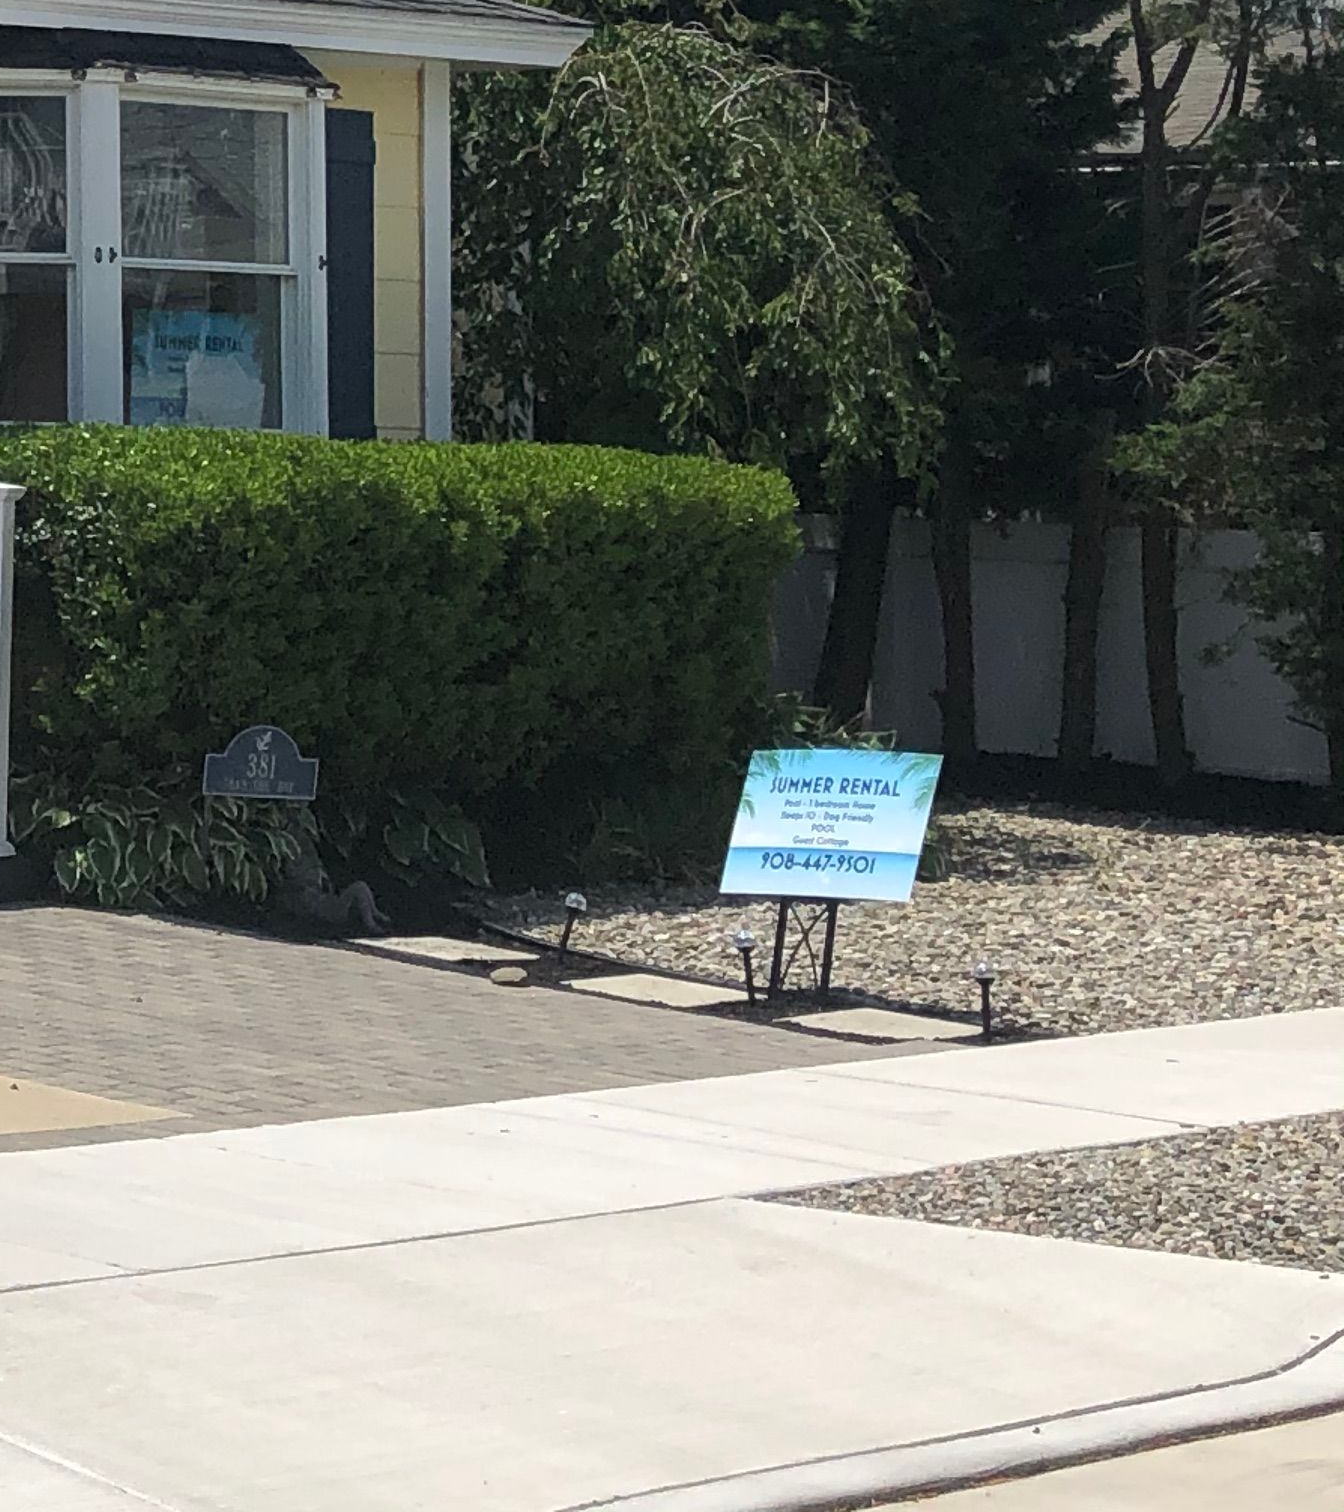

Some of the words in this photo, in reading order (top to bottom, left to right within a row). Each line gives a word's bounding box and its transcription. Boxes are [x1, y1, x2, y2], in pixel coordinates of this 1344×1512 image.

[154, 334, 200, 351] SUMMER
[205, 335, 243, 353] RENTAL
[246, 753, 276, 779] 381
[770, 776, 834, 794] SUMMER
[839, 777, 900, 797] RENTAL
[823, 811, 840, 822] Dog
[842, 812, 874, 824] Friendly
[811, 823, 835, 833] POOL
[792, 835, 815, 845] Guest
[816, 837, 849, 848] Cottage
[761, 852, 876, 874] 908-447-9501
